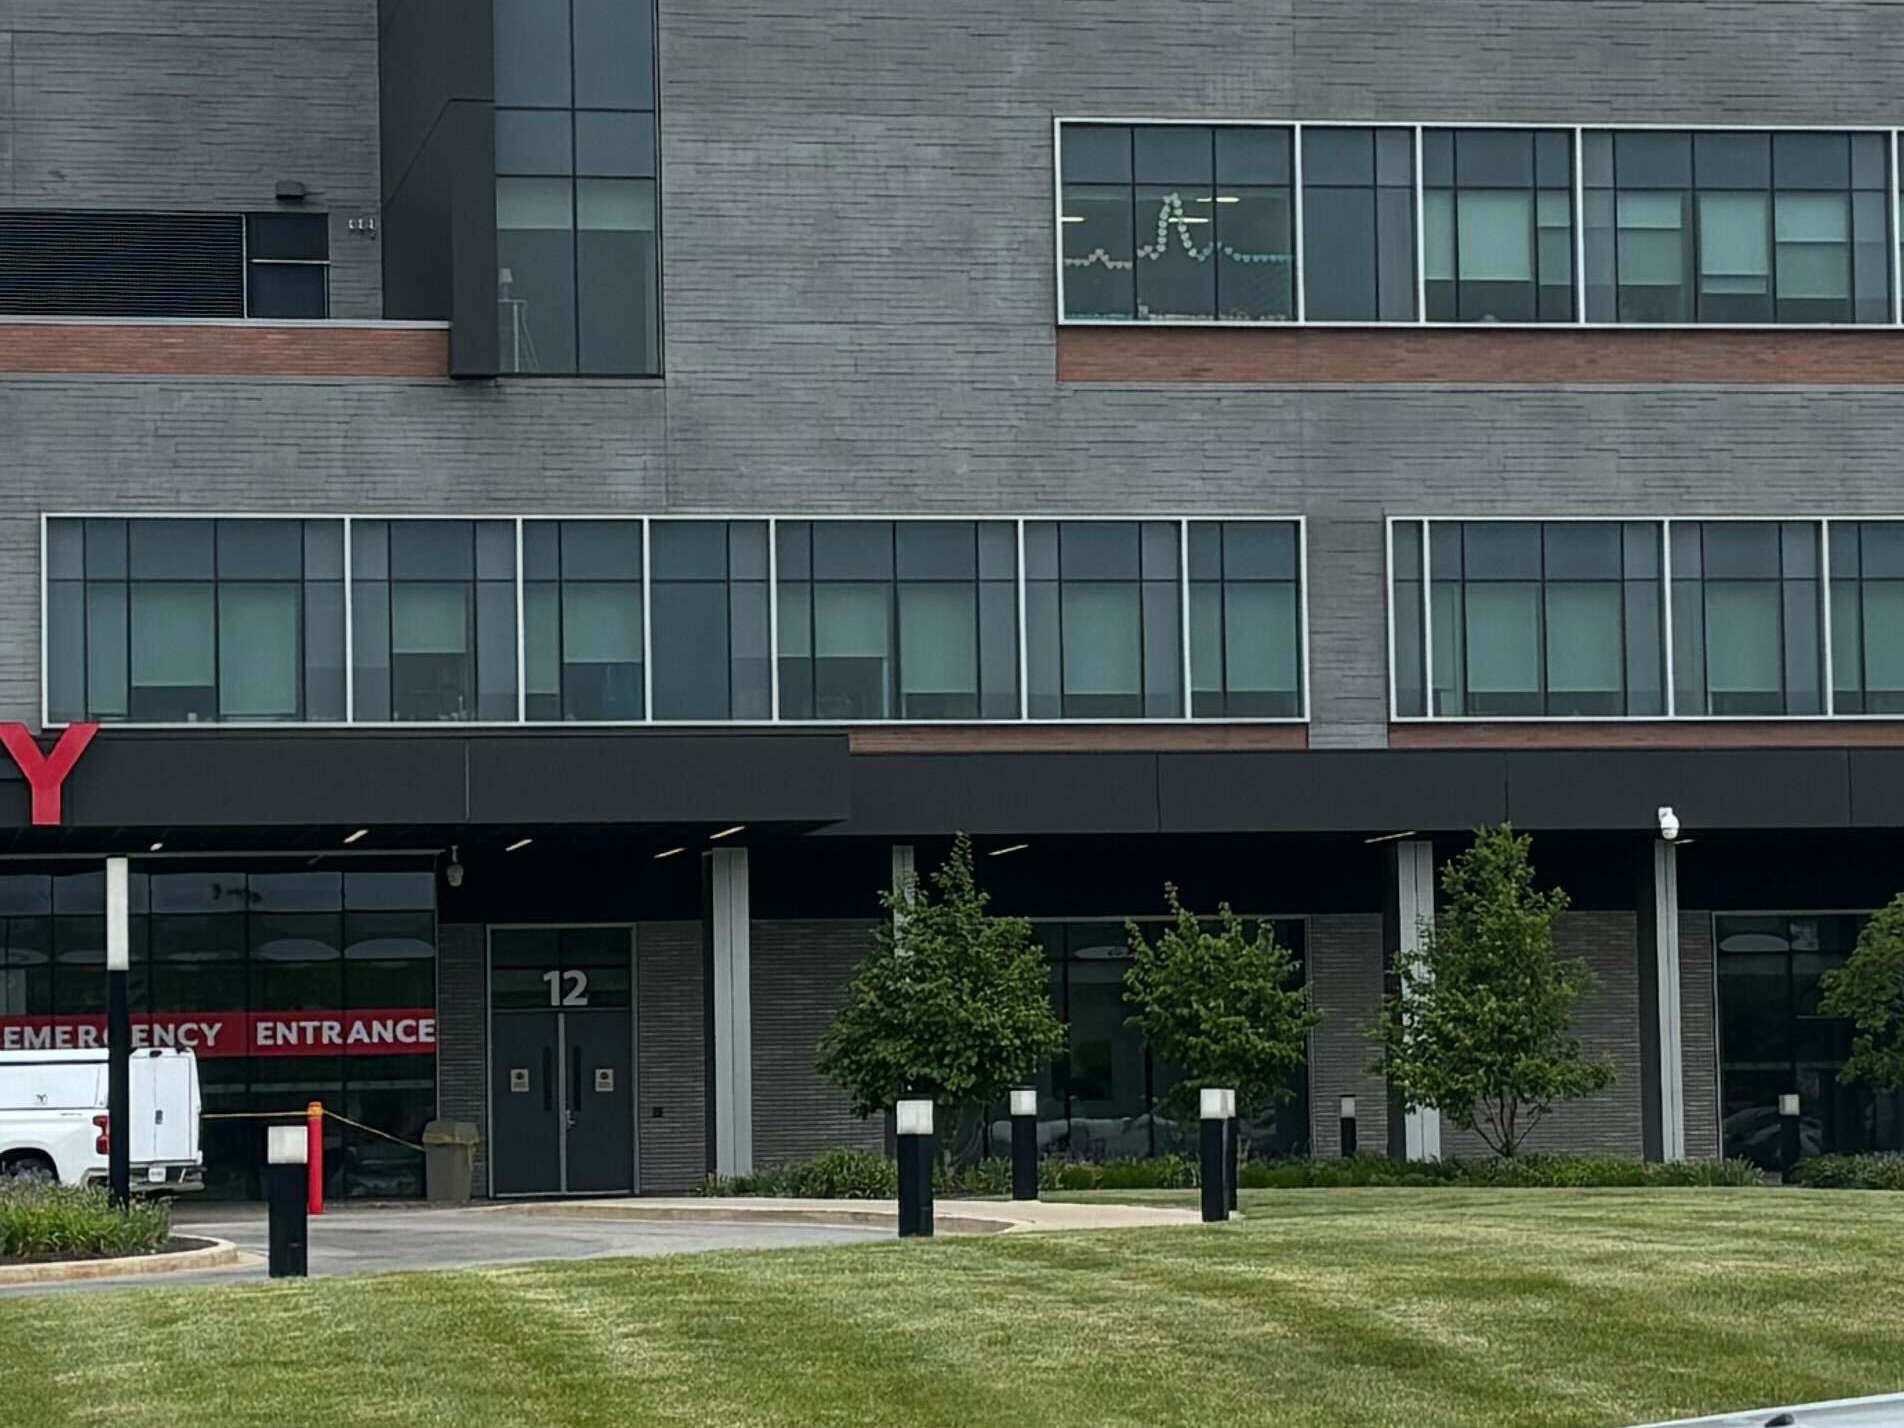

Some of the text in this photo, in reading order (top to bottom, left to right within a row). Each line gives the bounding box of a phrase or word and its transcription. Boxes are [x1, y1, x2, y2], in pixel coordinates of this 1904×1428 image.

[543, 969, 588, 1006] 12
[3, 1018, 436, 1050] EMERENCY ENTRANCE
